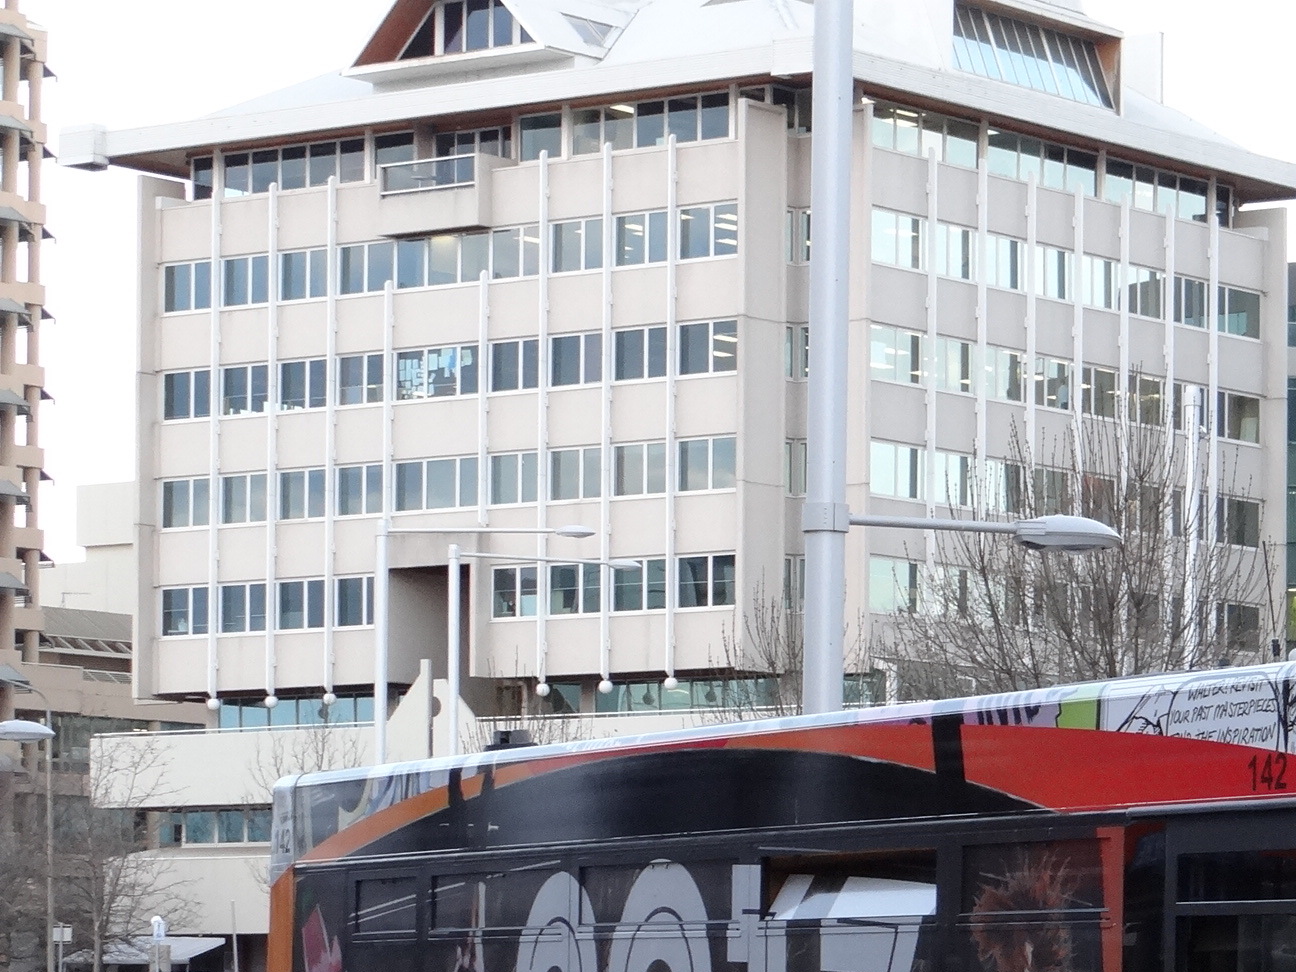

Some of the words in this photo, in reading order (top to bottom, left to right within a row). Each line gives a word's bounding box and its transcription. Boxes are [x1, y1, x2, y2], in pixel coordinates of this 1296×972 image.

[1192, 704, 1214, 722] PAST
[1217, 722, 1277, 745] INSPIRATION
[1248, 752, 1288, 791] 142
